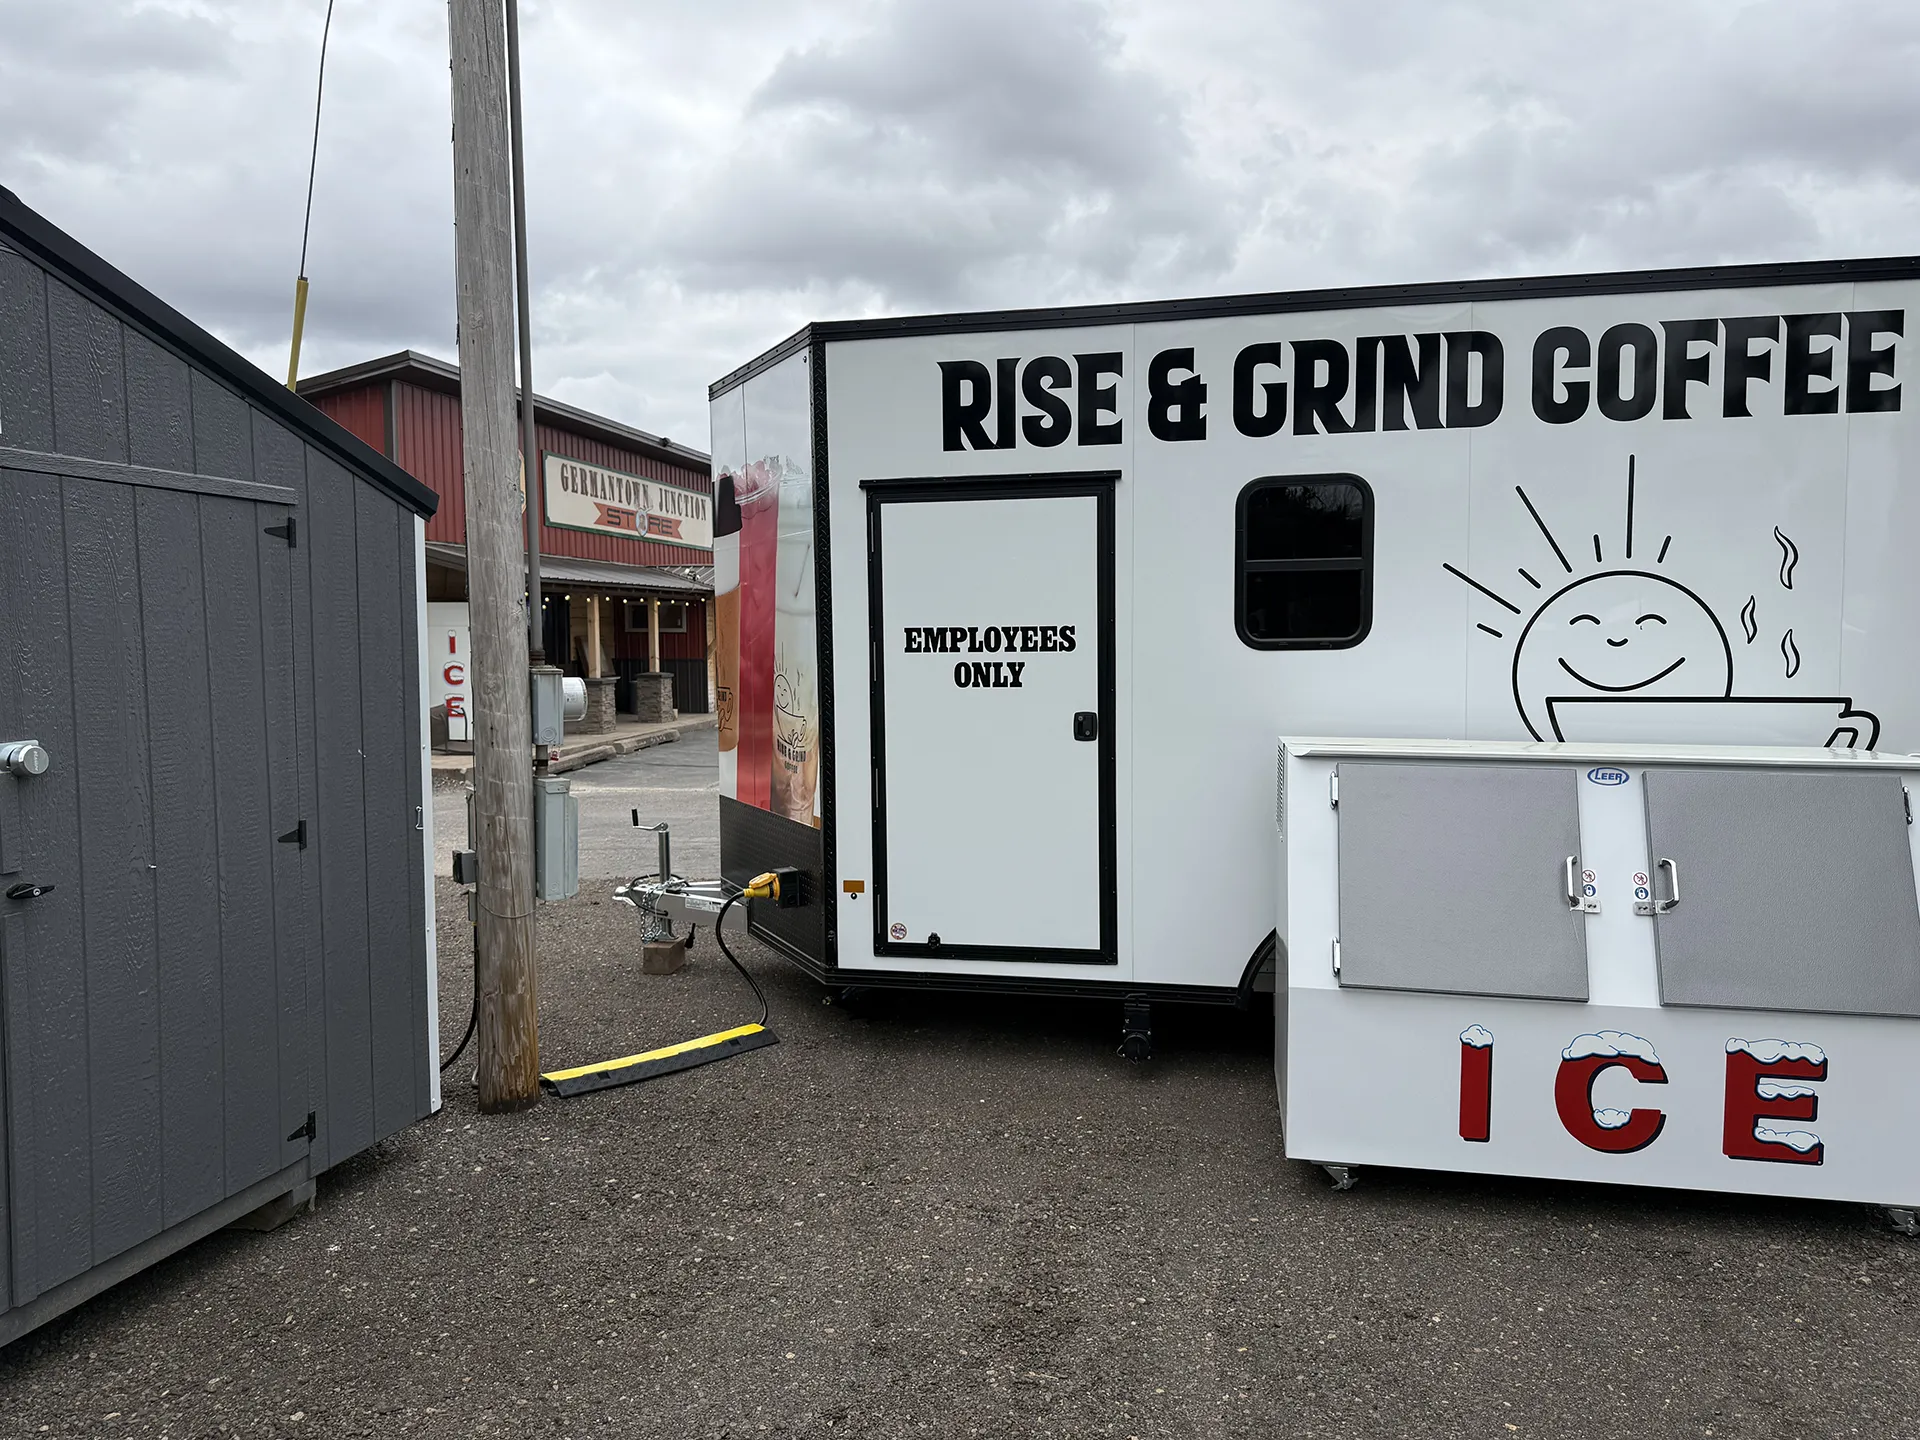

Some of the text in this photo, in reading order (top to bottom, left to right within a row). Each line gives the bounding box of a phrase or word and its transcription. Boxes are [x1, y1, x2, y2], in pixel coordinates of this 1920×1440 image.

[936, 309, 1905, 452] RISE & GRIND COFFEE
[560, 463, 707, 521] GERMANTOWN JUNCTION
[903, 626, 1077, 653] EMPLOYEES
[443, 630, 465, 718] ICE
[953, 661, 1026, 688] ONLY
[1594, 768, 1623, 785] LEER
[1458, 1023, 1829, 1167] ICE
